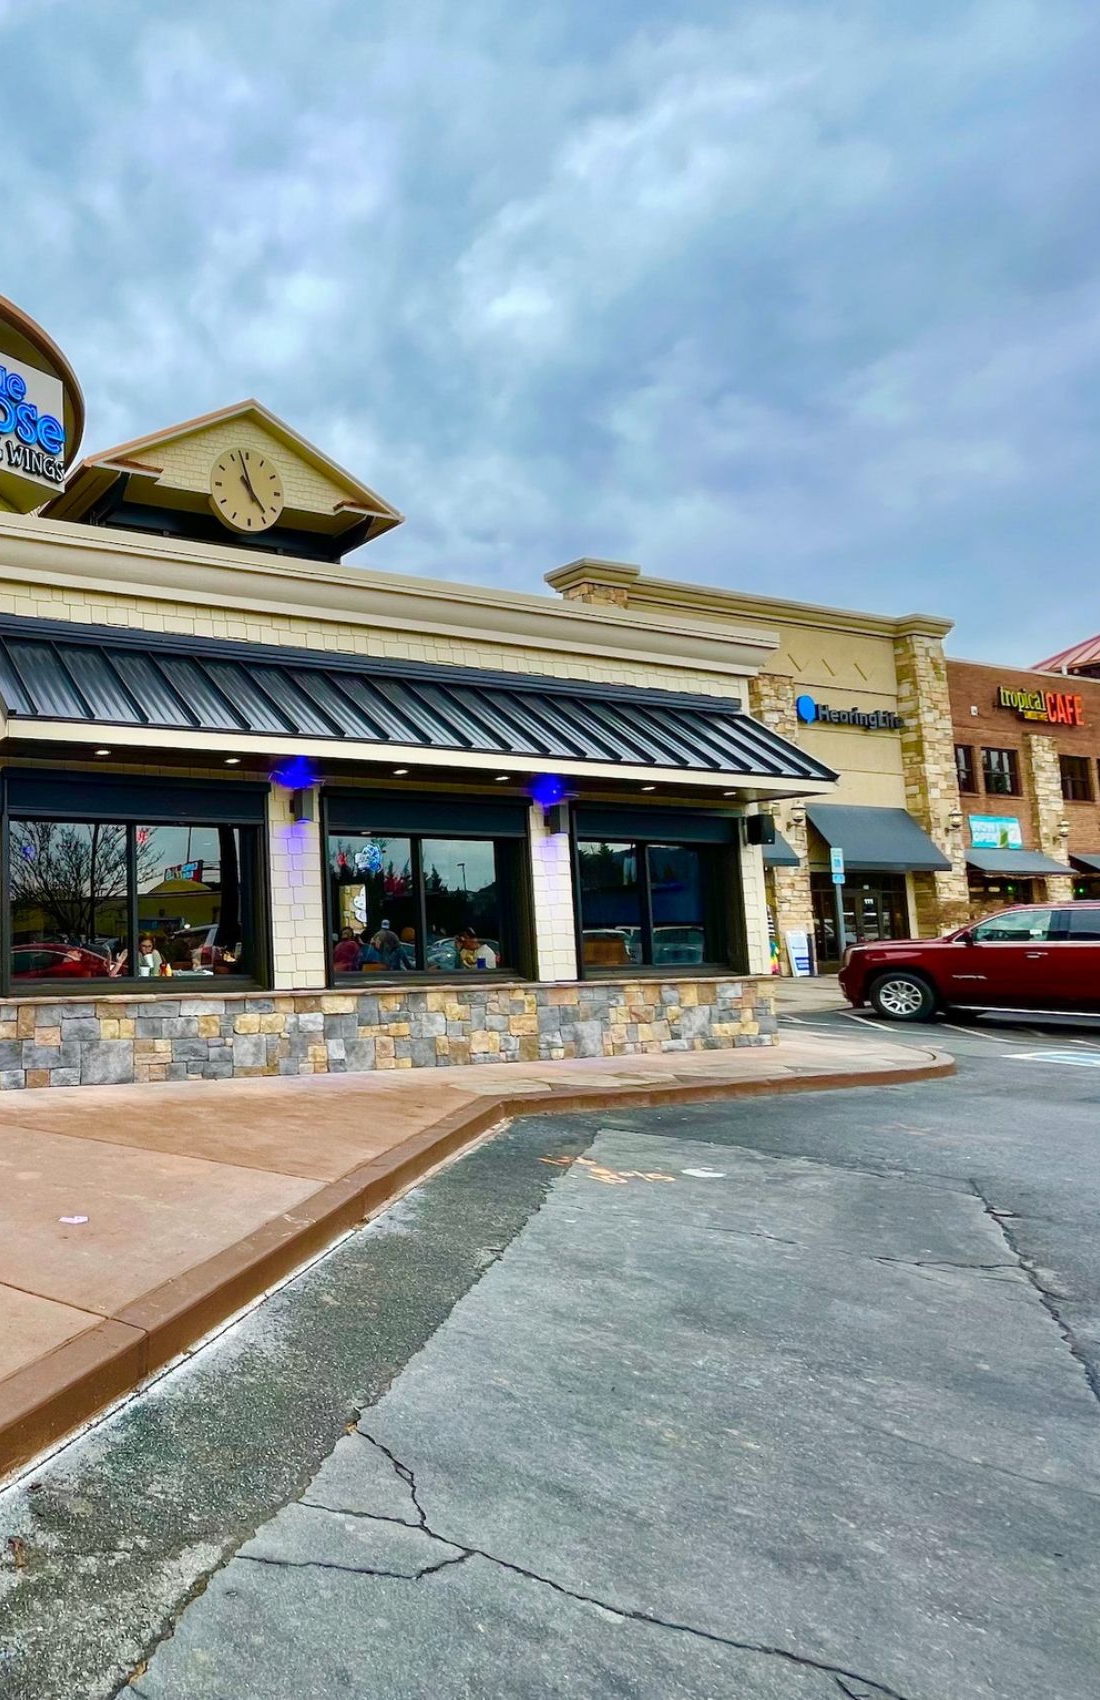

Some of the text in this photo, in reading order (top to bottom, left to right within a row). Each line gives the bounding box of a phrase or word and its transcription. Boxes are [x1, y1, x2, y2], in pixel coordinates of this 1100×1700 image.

[6, 440, 66, 483] WINGS
[999, 687, 1085, 726] tropical CAFE
